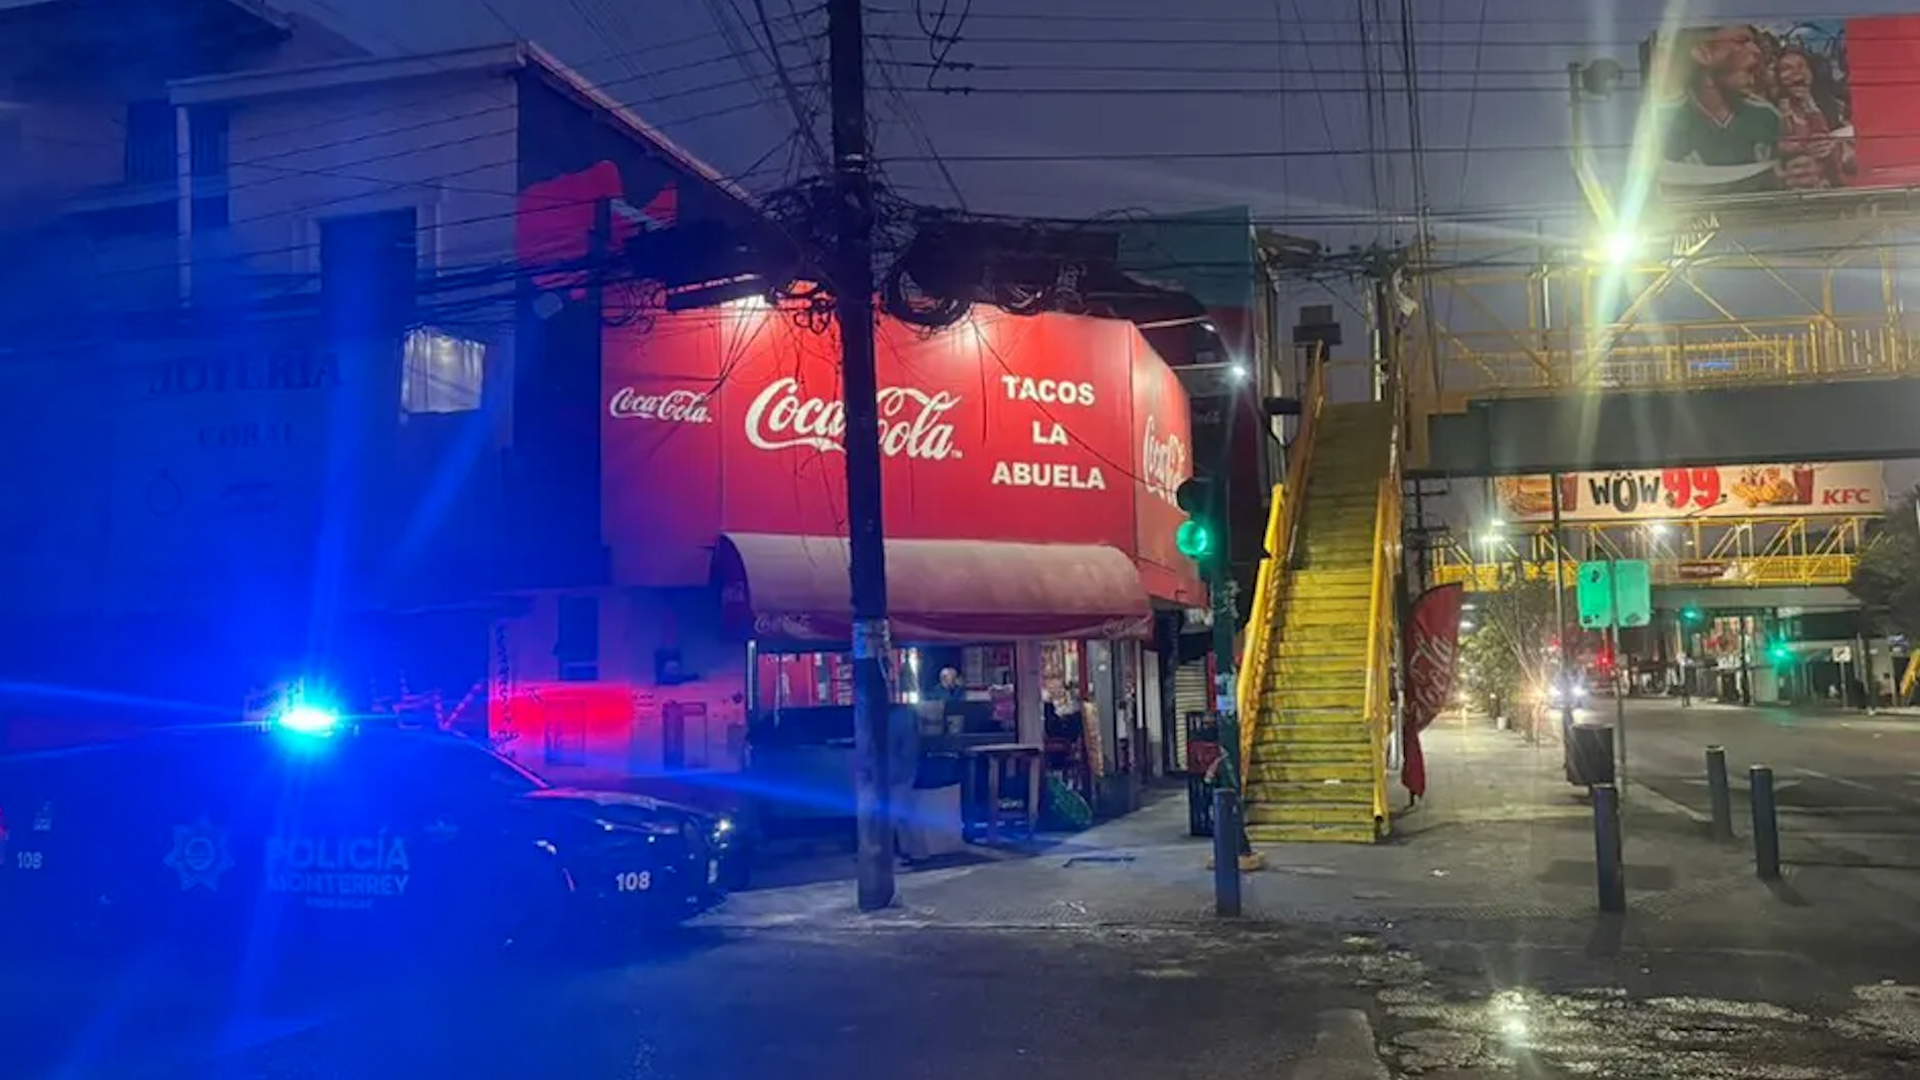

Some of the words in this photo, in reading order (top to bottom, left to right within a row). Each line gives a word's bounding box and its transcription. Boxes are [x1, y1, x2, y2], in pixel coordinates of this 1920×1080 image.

[1003, 375, 1095, 406] TACOS
[610, 386, 709, 424] Coca-Cola
[744, 377, 962, 461] Cocaola
[1034, 423, 1069, 446] LA
[992, 461, 1106, 491] ABUELA
[1822, 488, 1871, 506] KFC
[16, 851, 43, 870] 108
[265, 827, 409, 870] POLICÍA
[265, 873, 409, 895] MONTERREY
[615, 870, 651, 891] 108
